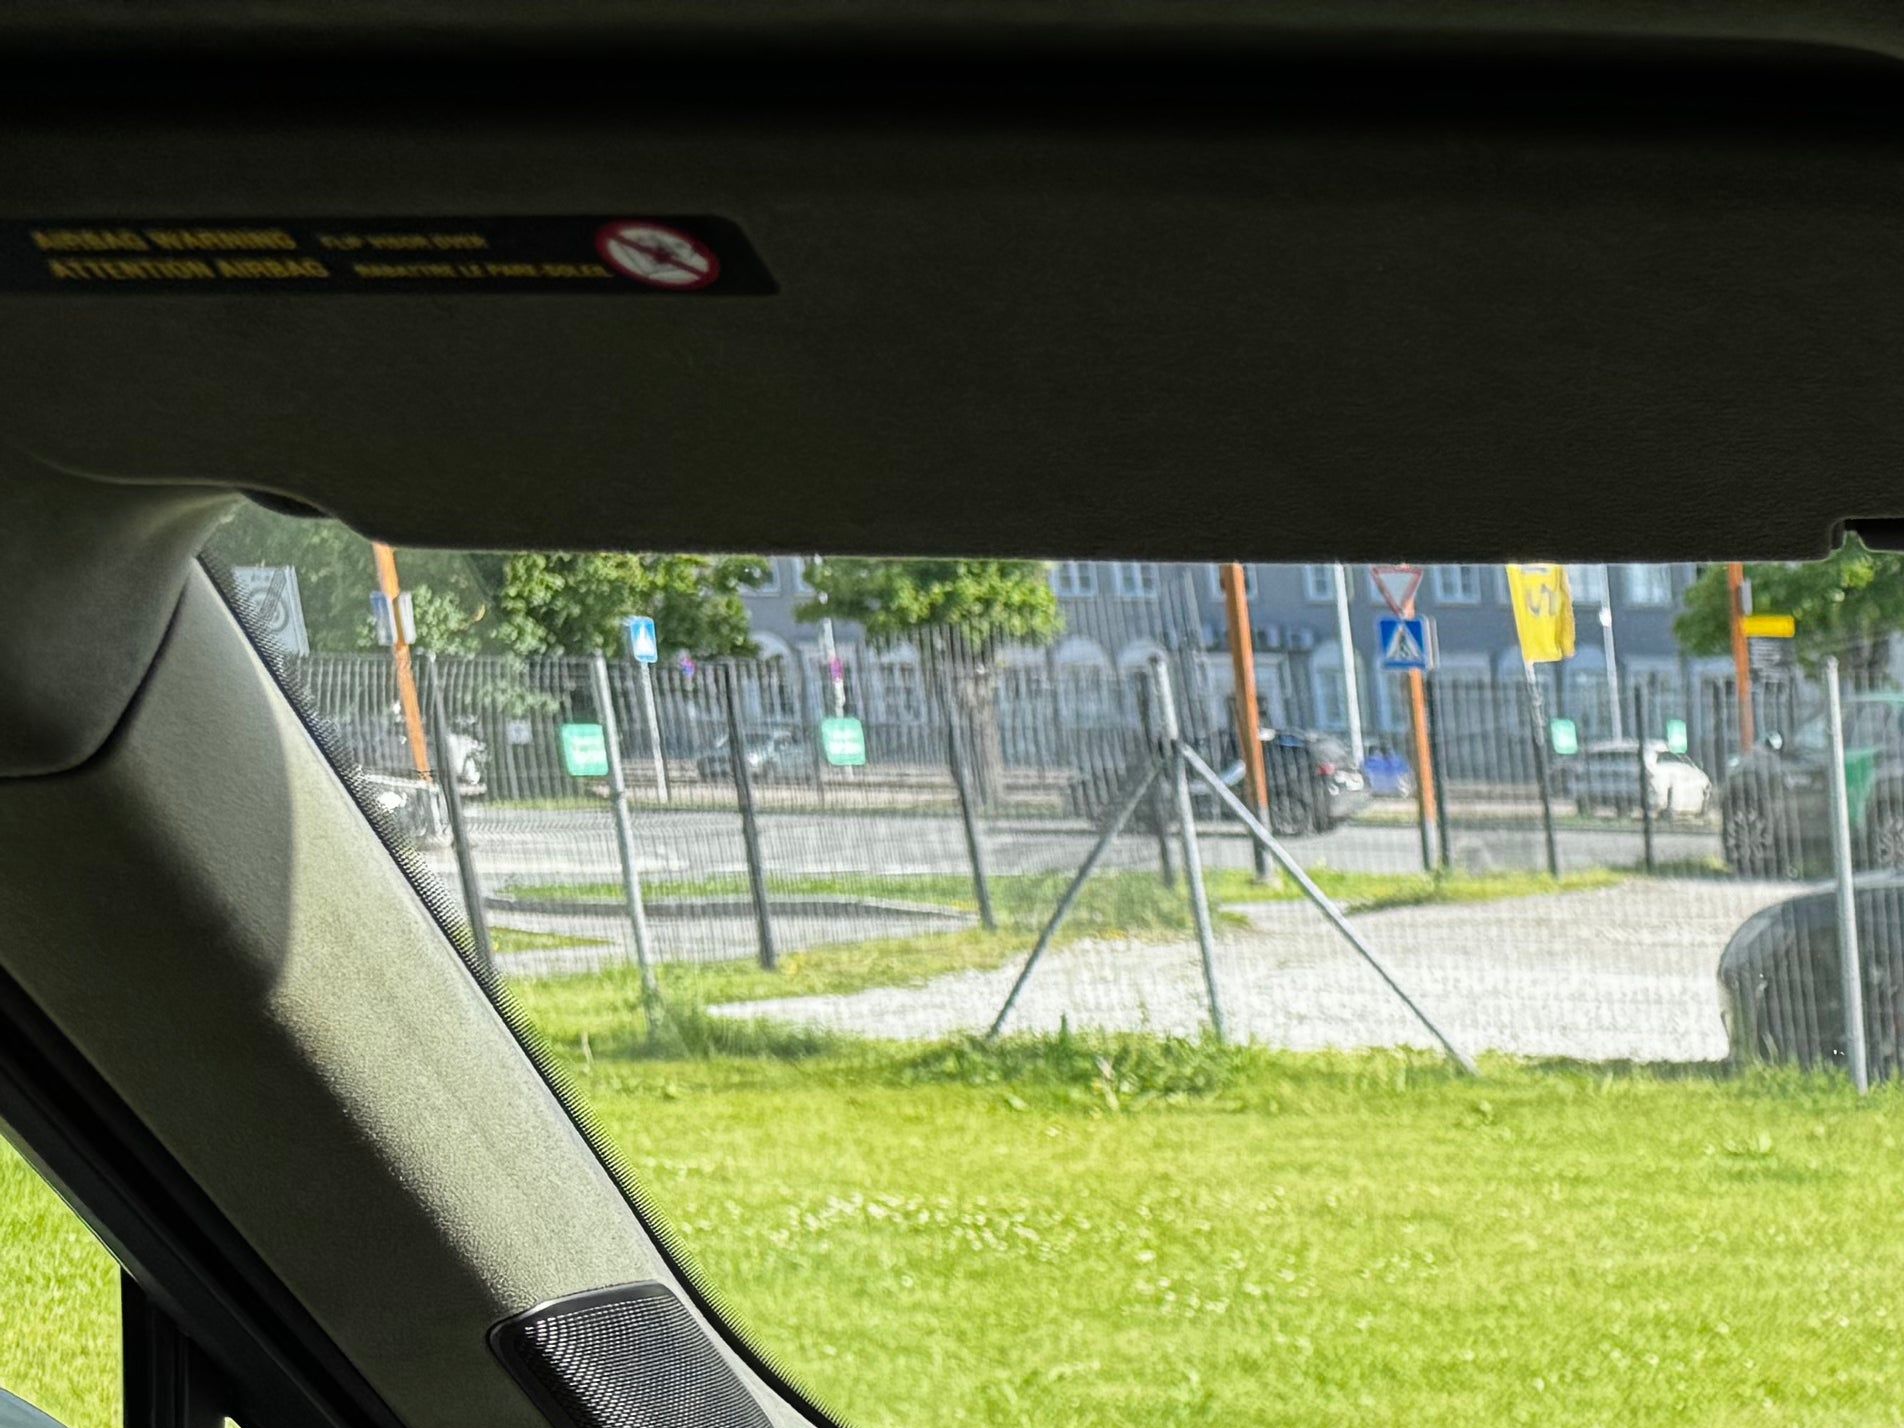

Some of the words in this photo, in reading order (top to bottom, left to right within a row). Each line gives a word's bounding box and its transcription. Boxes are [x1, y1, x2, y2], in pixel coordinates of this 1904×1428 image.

[142, 228, 296, 250] WARNING
[48, 257, 215, 279] ATTENTION
[213, 257, 330, 278] AIRBAG
